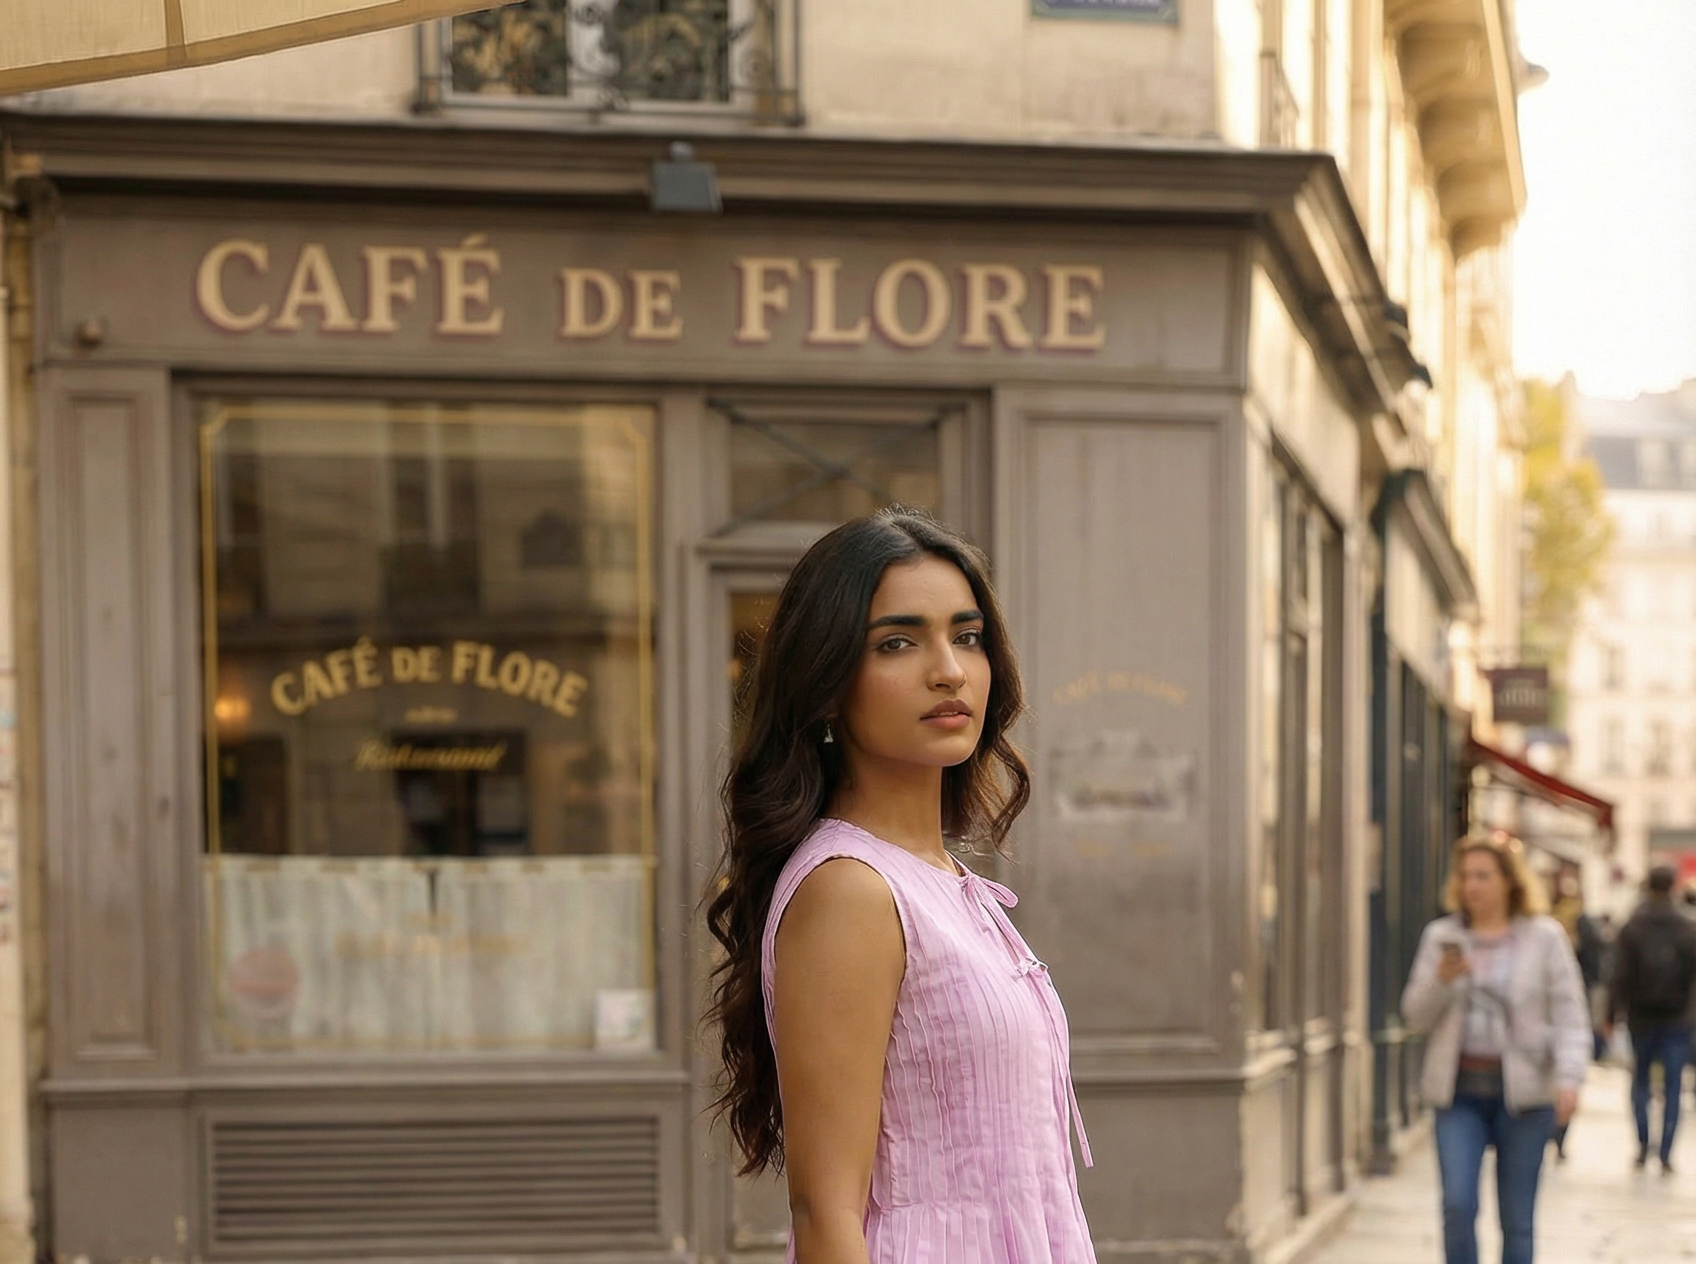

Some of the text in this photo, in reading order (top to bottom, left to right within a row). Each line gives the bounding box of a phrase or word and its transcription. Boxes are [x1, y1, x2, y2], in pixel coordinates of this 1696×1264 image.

[197, 232, 1107, 351] CAFÉ DE FLORE
[270, 636, 590, 718] CAFÉ DE FLORE
